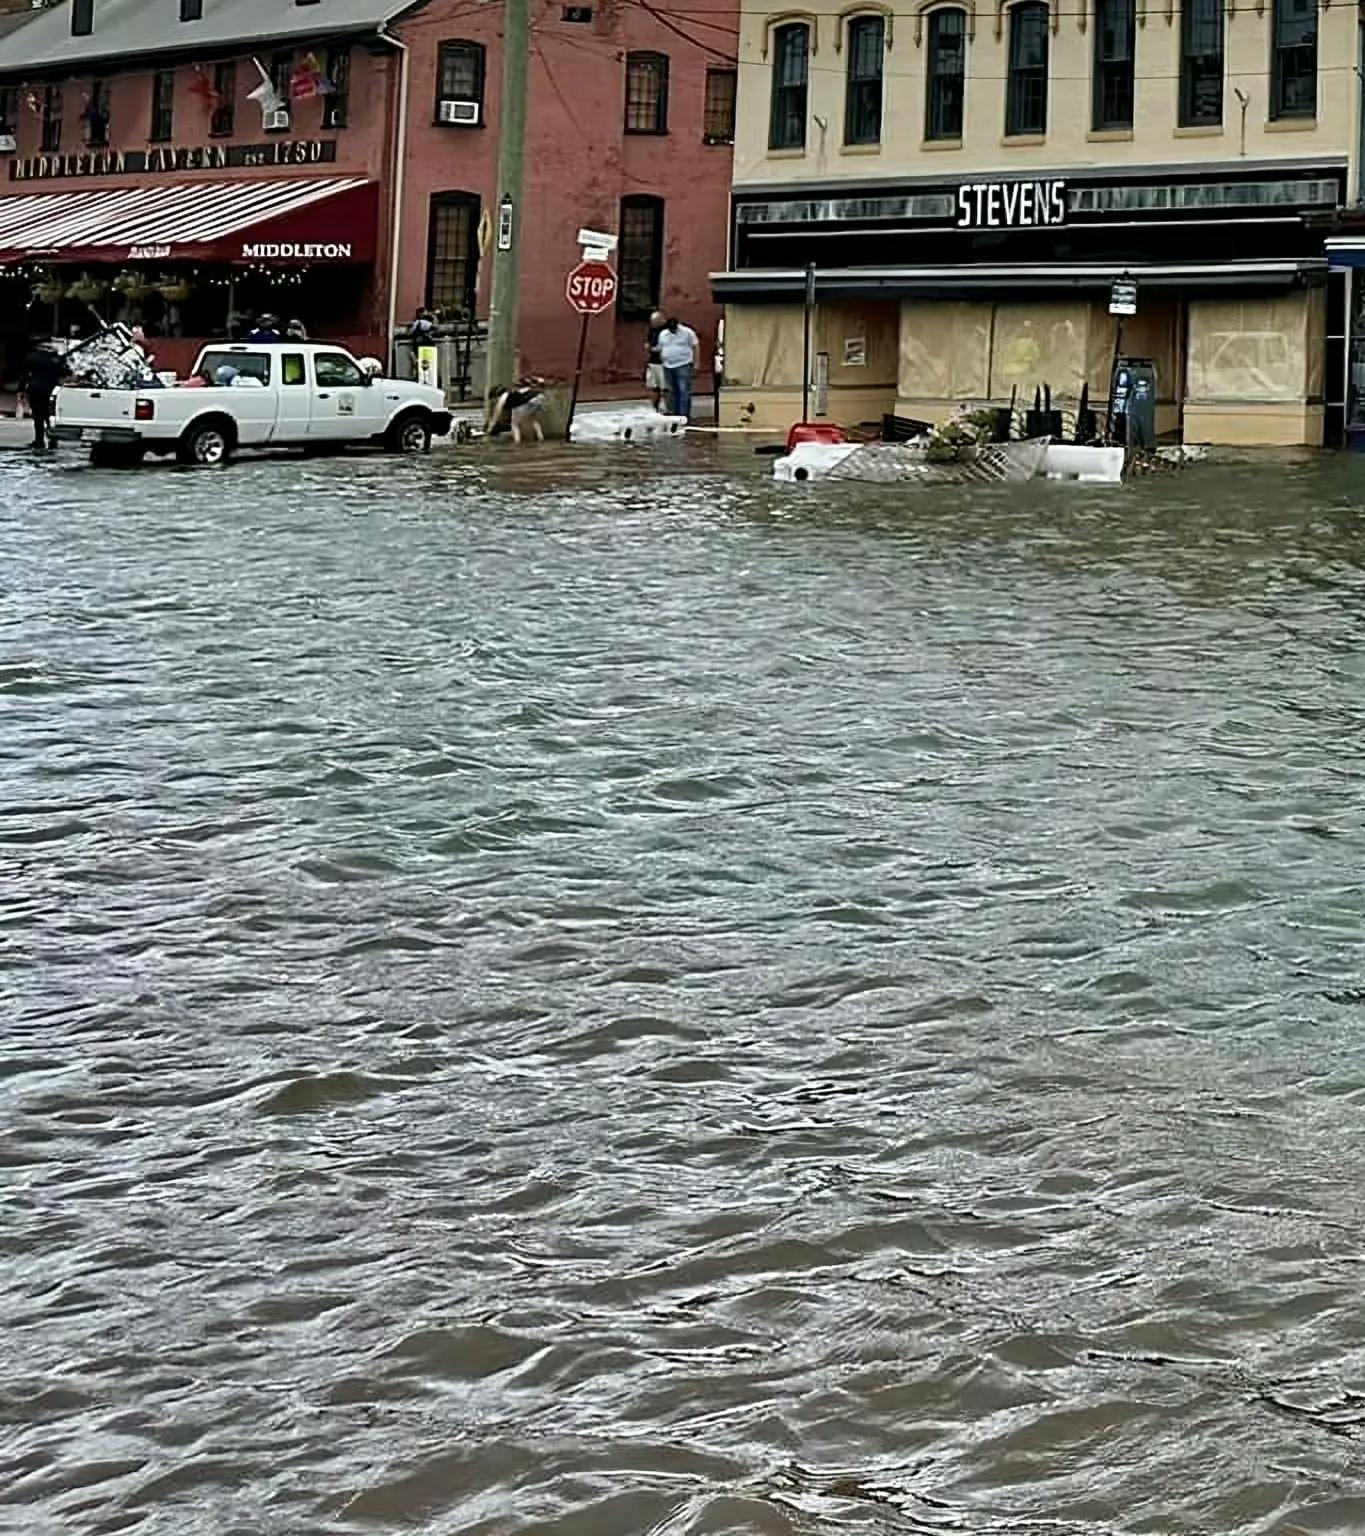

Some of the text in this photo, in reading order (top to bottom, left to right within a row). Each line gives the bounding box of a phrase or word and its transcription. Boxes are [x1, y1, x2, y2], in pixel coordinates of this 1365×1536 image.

[957, 180, 1065, 227] STEVENS
[242, 243, 351, 258] MIDDLETON
[571, 276, 613, 297] STOP
